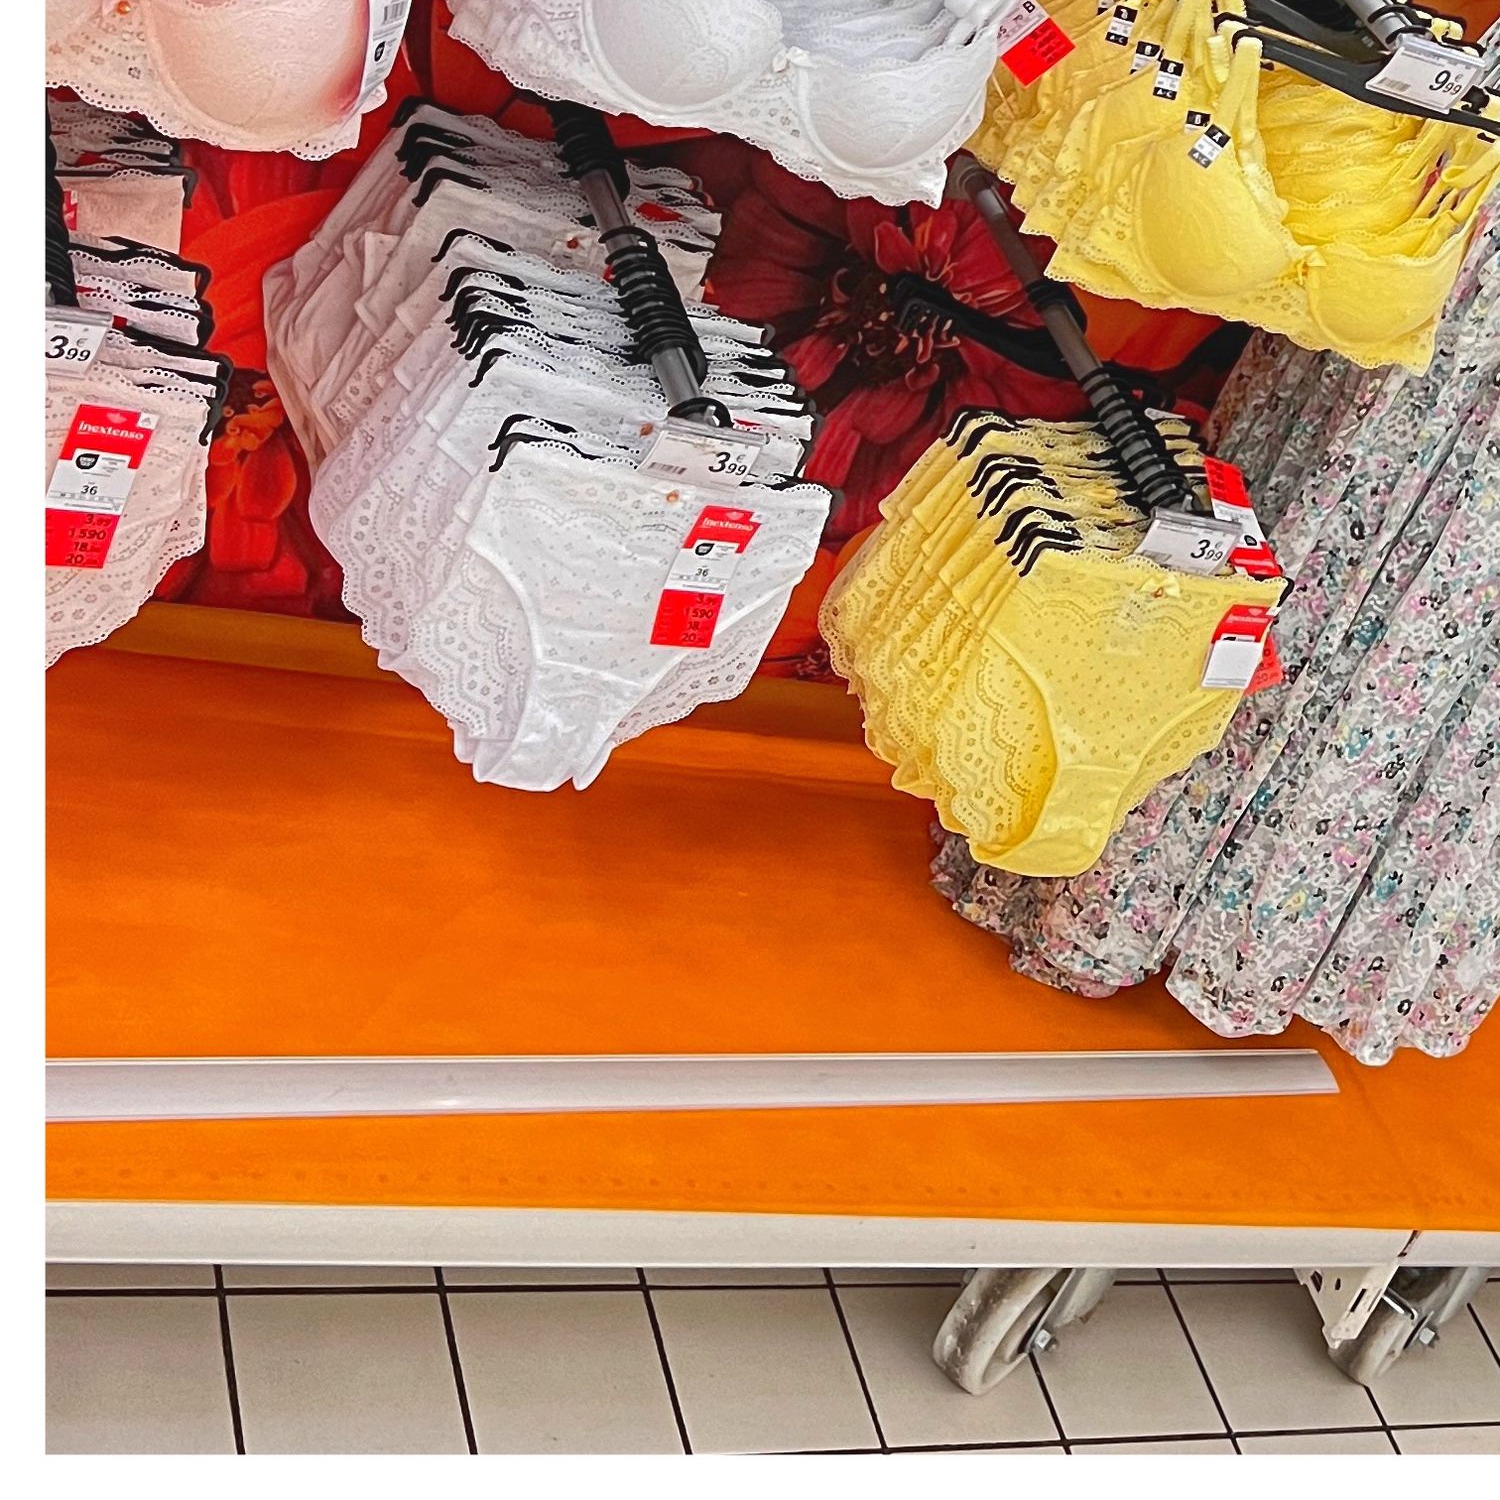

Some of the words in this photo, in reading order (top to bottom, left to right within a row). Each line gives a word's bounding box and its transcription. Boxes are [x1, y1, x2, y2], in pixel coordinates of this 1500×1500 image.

[1022, 0, 1036, 14] B
[80, 484, 99, 496] 36
[695, 568, 710, 577] 36
